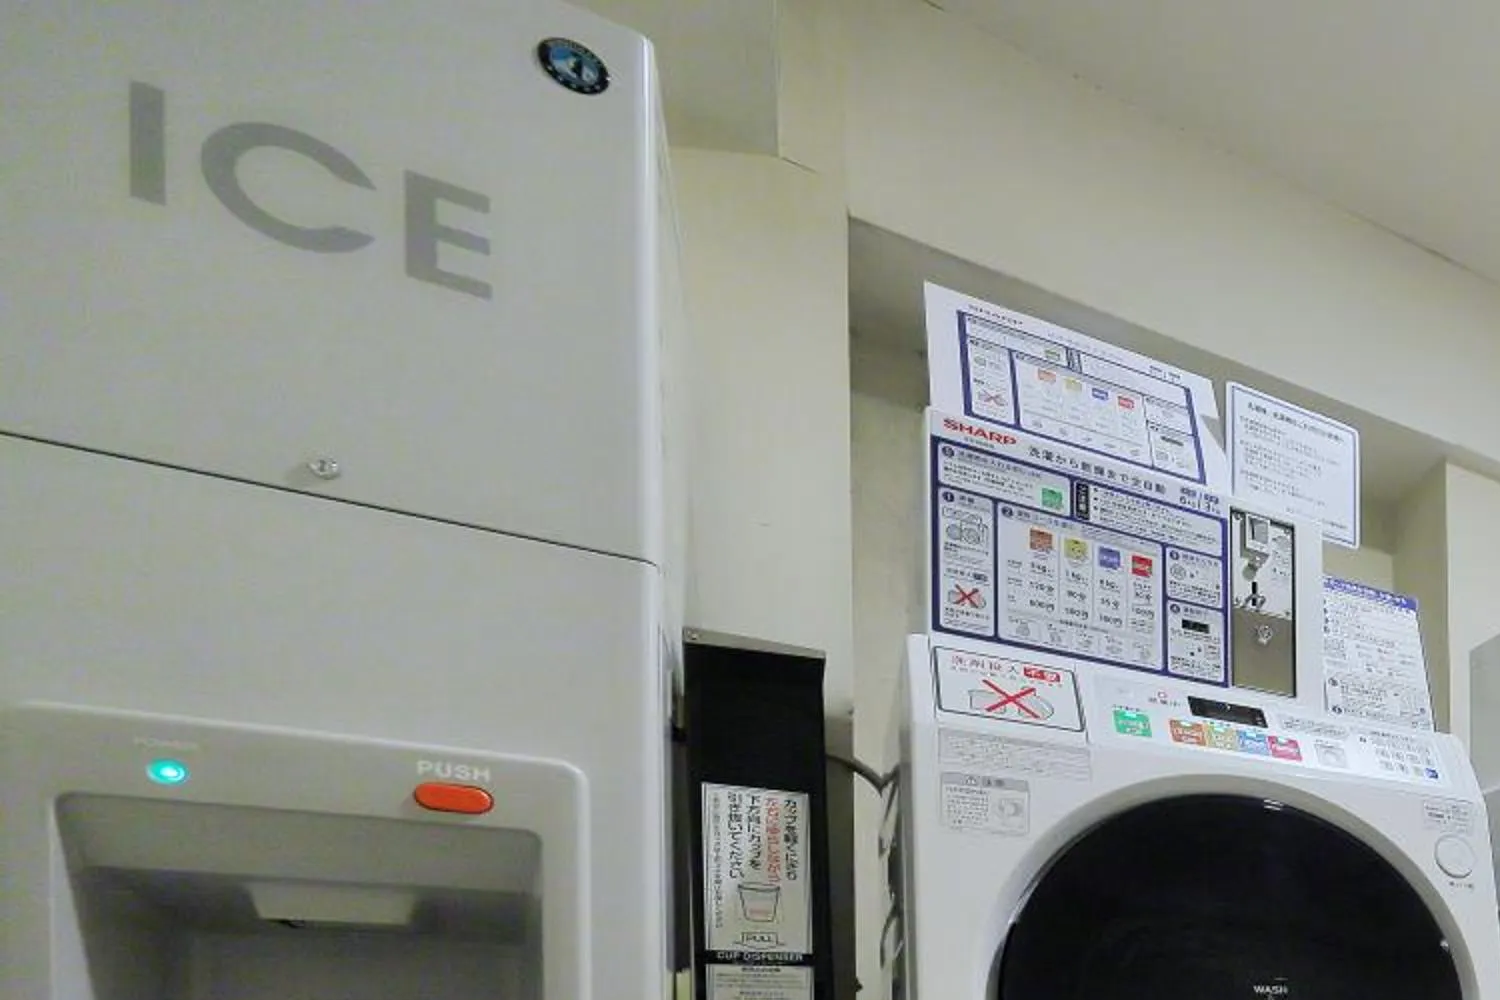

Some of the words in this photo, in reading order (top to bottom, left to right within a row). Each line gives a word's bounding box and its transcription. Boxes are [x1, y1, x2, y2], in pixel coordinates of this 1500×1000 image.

[129, 80, 492, 300] ICE
[943, 418, 1017, 446] SHARP
[416, 760, 491, 782] PUSH
[1253, 985, 1288, 994] WASH
